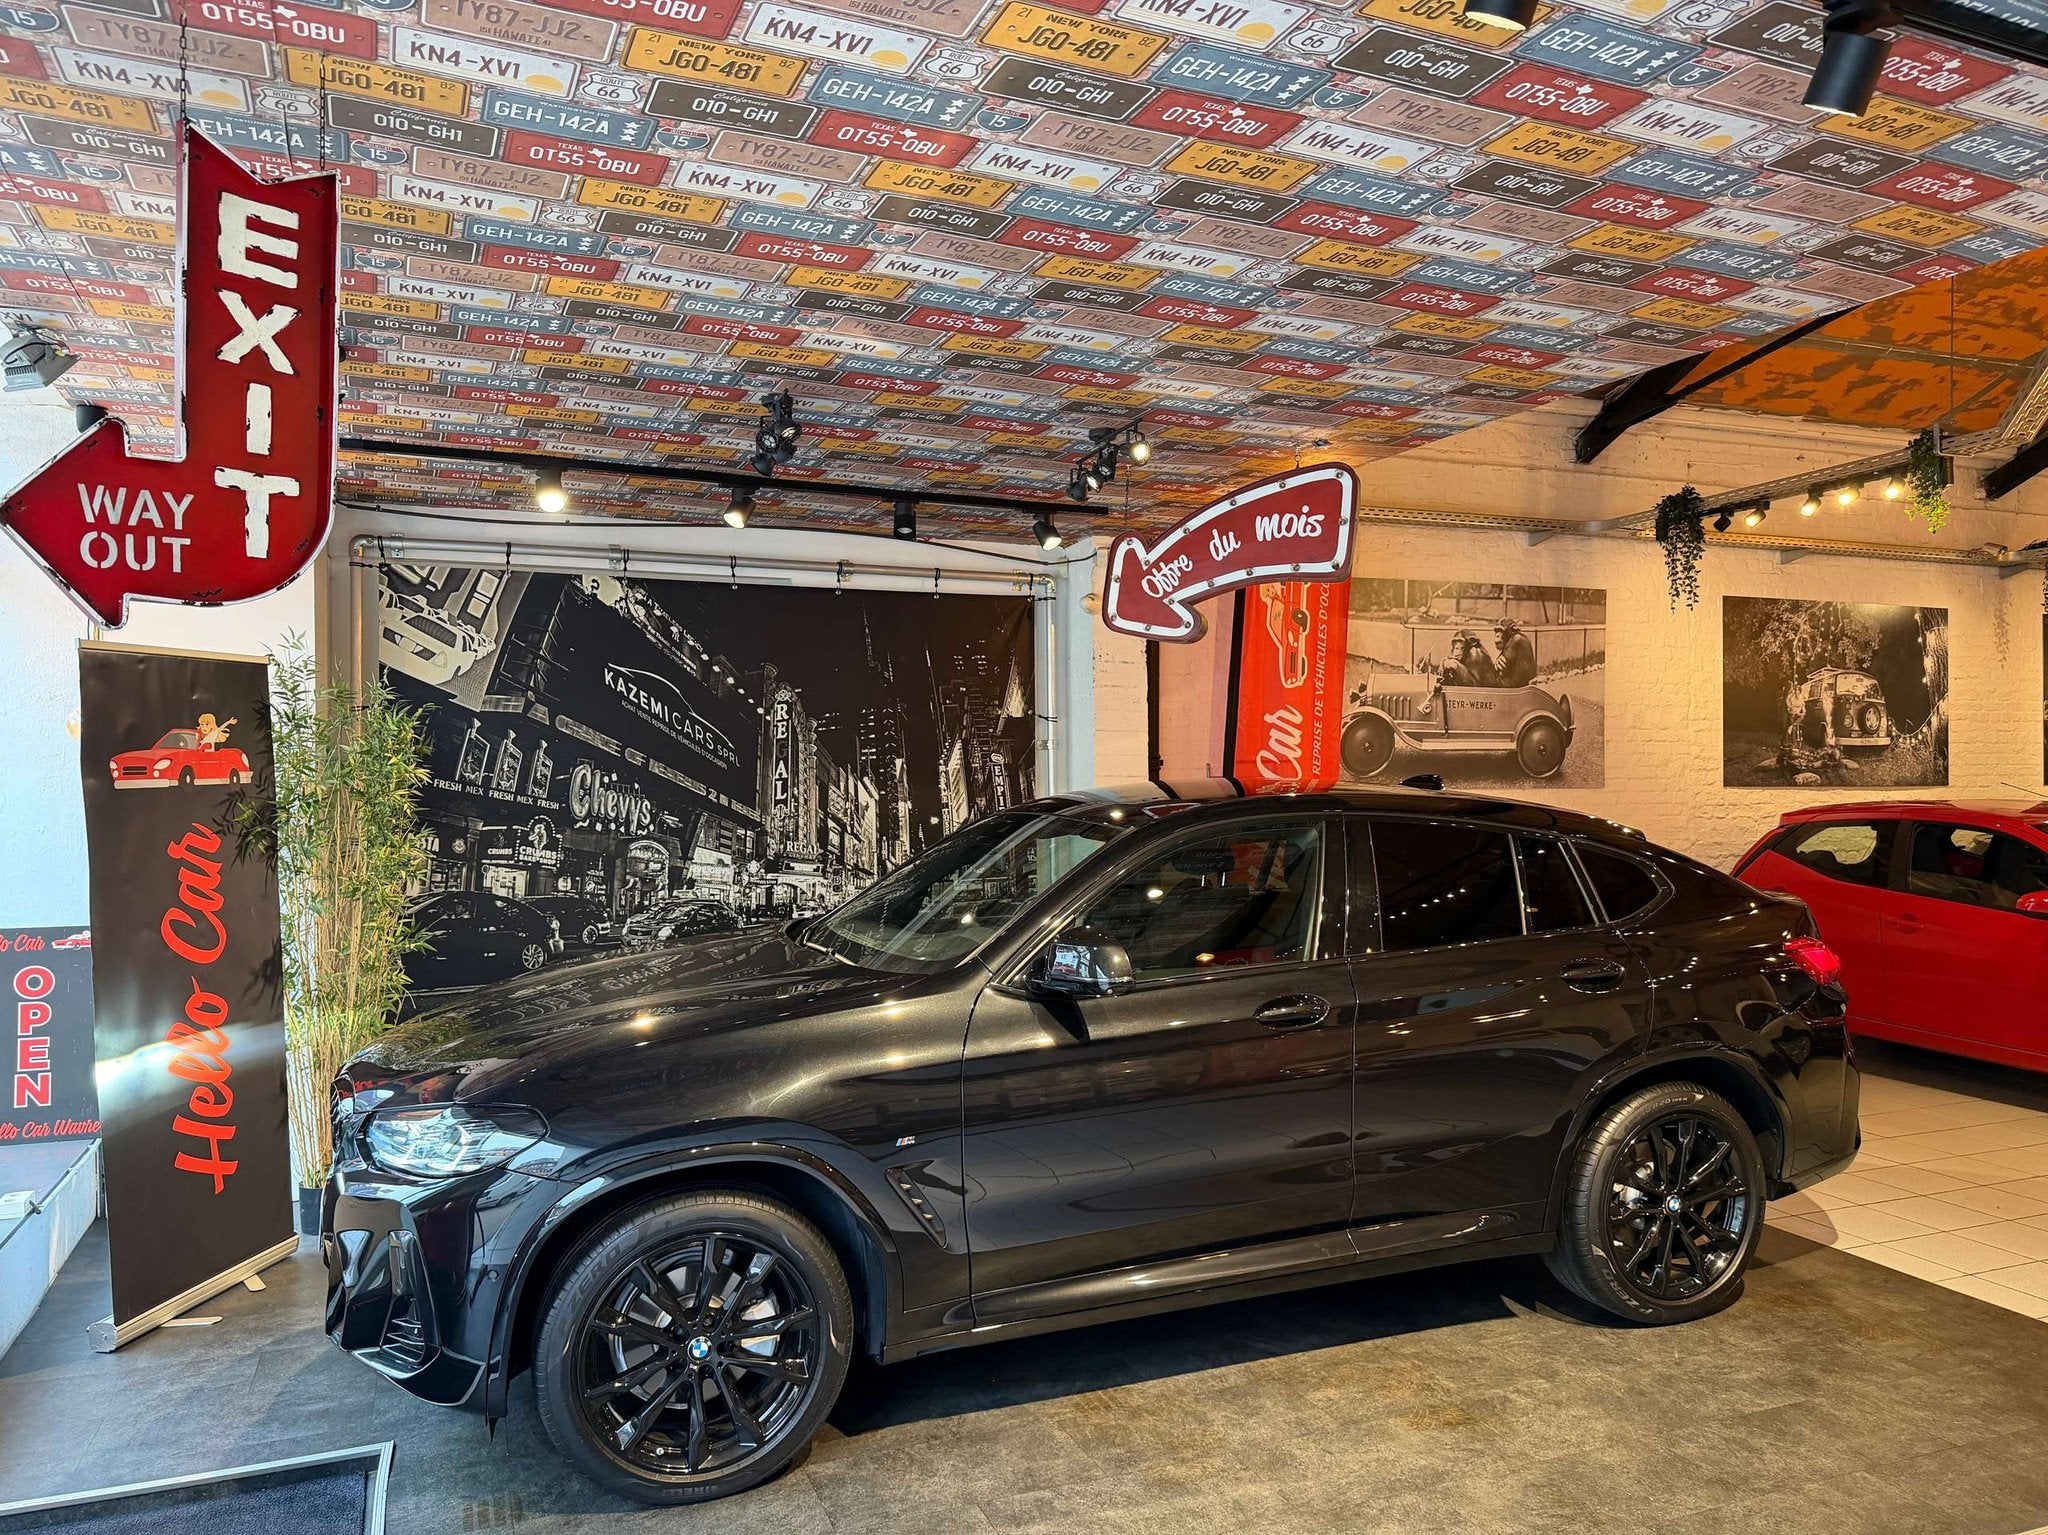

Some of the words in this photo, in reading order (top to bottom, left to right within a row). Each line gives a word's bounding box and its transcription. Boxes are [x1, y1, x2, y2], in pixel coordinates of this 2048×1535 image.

[10, 9, 37, 27] 15
[1685, 6, 1713, 25] 66
[1046, 15, 1084, 29] NEW
[1086, 24, 1132, 40] YORK
[1136, 37, 1158, 48] 82
[1296, 33, 1330, 49] 66
[679, 39, 716, 52] NEW
[722, 48, 768, 62] YORK
[1533, 26, 1654, 68] GEH-142A
[1926, 50, 1944, 64] TEXAS
[334, 60, 371, 72] NEW
[380, 68, 427, 82] YORK
[936, 61, 966, 75] 66
[1166, 53, 1287, 93] GEH-142A
[1676, 67, 1710, 83] 15
[595, 85, 621, 99] 66
[1549, 76, 1580, 88] TEXAS
[819, 77, 940, 114] GEH-142A
[1199, 100, 1229, 110] TEXAS
[1321, 91, 1351, 105] 15
[493, 100, 613, 135] GEH-142A
[869, 121, 898, 131] TEXAS
[986, 114, 1011, 128] 15
[556, 141, 584, 151] TEXAS
[670, 134, 691, 147] 15
[1943, 135, 2043, 165] GEH-142A
[1620, 158, 1720, 186] GEH-142A
[1311, 177, 1411, 204] GEH-142A
[1017, 195, 1117, 221] GEH-142A
[738, 210, 837, 235] GEH-142A
[471, 223, 570, 247] GEH-142A
[1415, 265, 1500, 285] GEH-142A
[917, 291, 1001, 310] GEH-142A
[1160, 280, 1244, 299] GEH-142A
[214, 191, 300, 559] EXIT
[78, 483, 195, 531] WAY
[1209, 528, 1241, 562] du
[1255, 504, 1325, 542] mois
[79, 530, 192, 574] OUT
[1313, 623, 1328, 696] VÉHICULES
[1314, 699, 1324, 718] DE
[775, 703, 790, 801] REGAL
[1256, 703, 1304, 781] Car
[1312, 720, 1323, 776] REPRISE
[717, 744, 741, 768] SPRL
[433, 778, 462, 792] FRESH
[465, 785, 484, 796] MEX
[489, 789, 514, 802] FRESH
[516, 794, 534, 805] MEX
[537, 799, 560, 810] FRESH
[569, 763, 651, 836] Chevys
[519, 846, 558, 859] CRUMBS
[160, 822, 228, 965] Car
[13, 933, 46, 952] Car
[13, 965, 56, 1108] OPEN
[163, 974, 239, 1196] Hello
[21, 1120, 51, 1139] Car
[53, 1118, 102, 1137] Wavre
